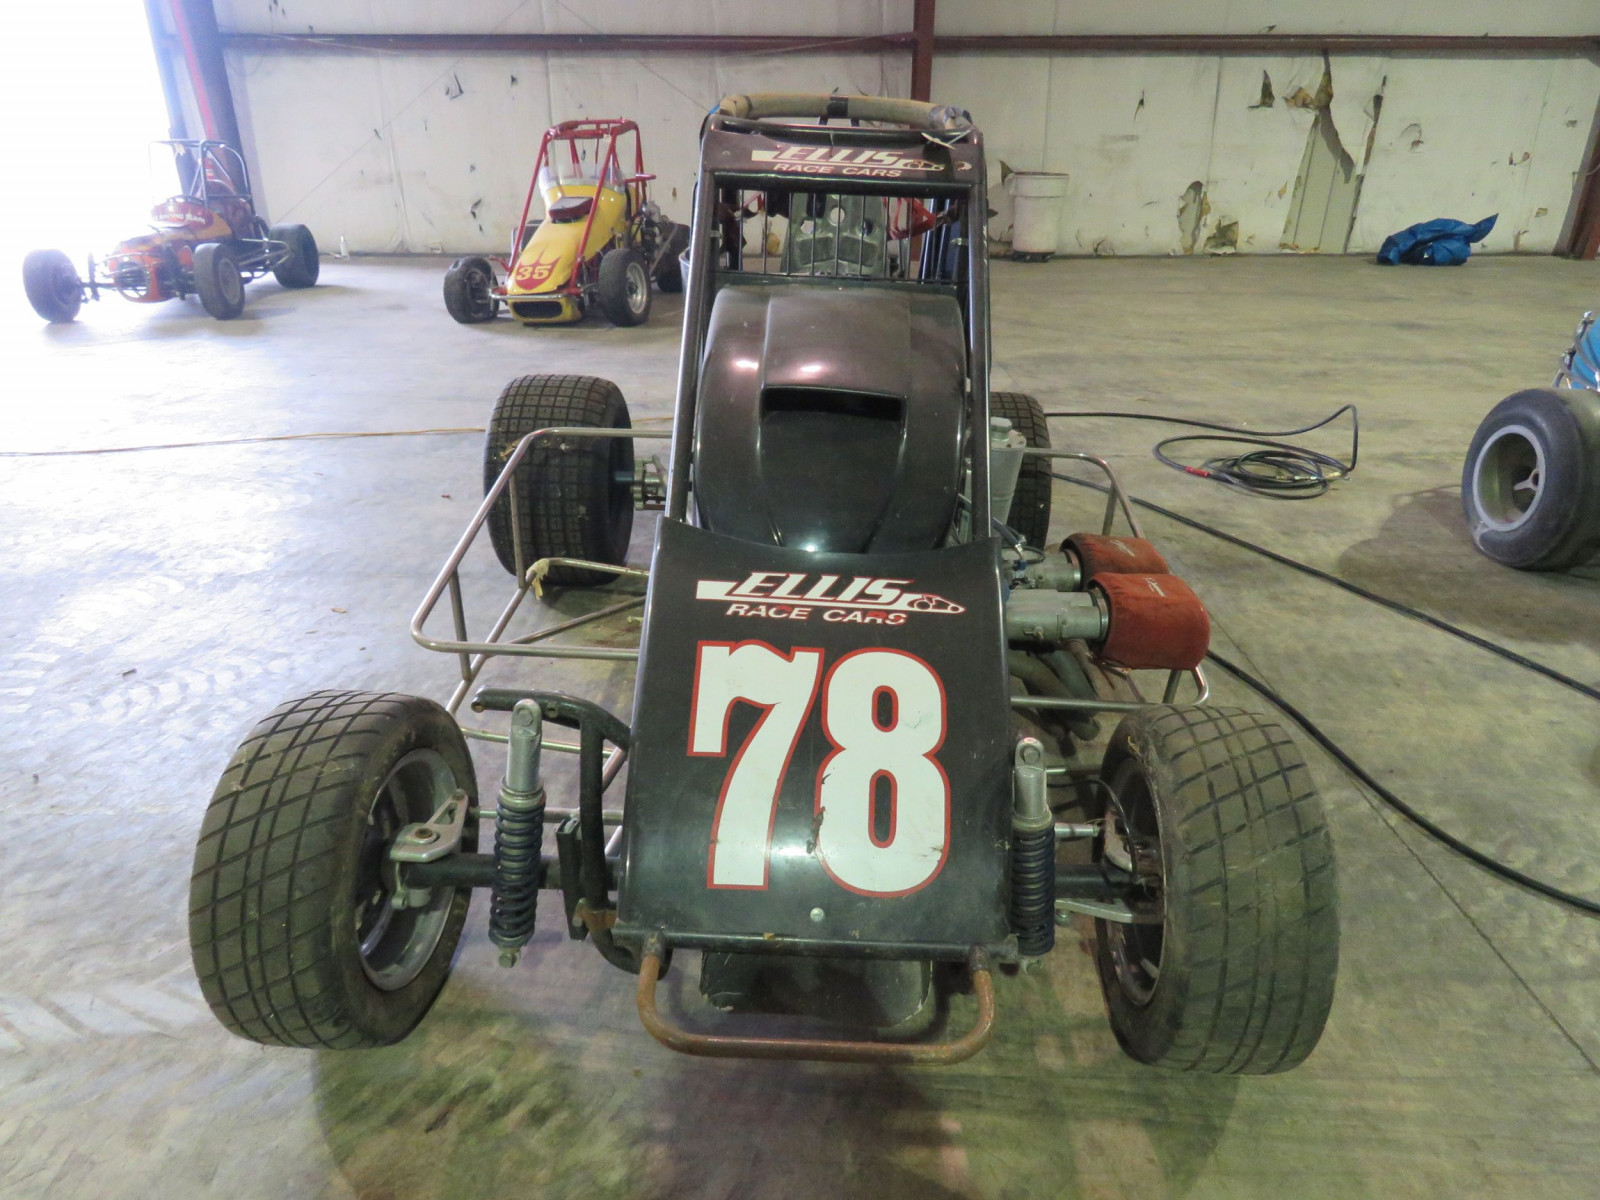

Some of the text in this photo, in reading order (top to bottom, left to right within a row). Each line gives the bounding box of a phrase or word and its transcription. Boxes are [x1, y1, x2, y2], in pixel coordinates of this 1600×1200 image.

[778, 146, 904, 165] ELLIS
[773, 163, 902, 177] RACE CARS
[516, 265, 552, 280] 35
[726, 571, 914, 604] ELLIS
[726, 603, 907, 625] RACE CARS
[686, 639, 951, 898] 78
